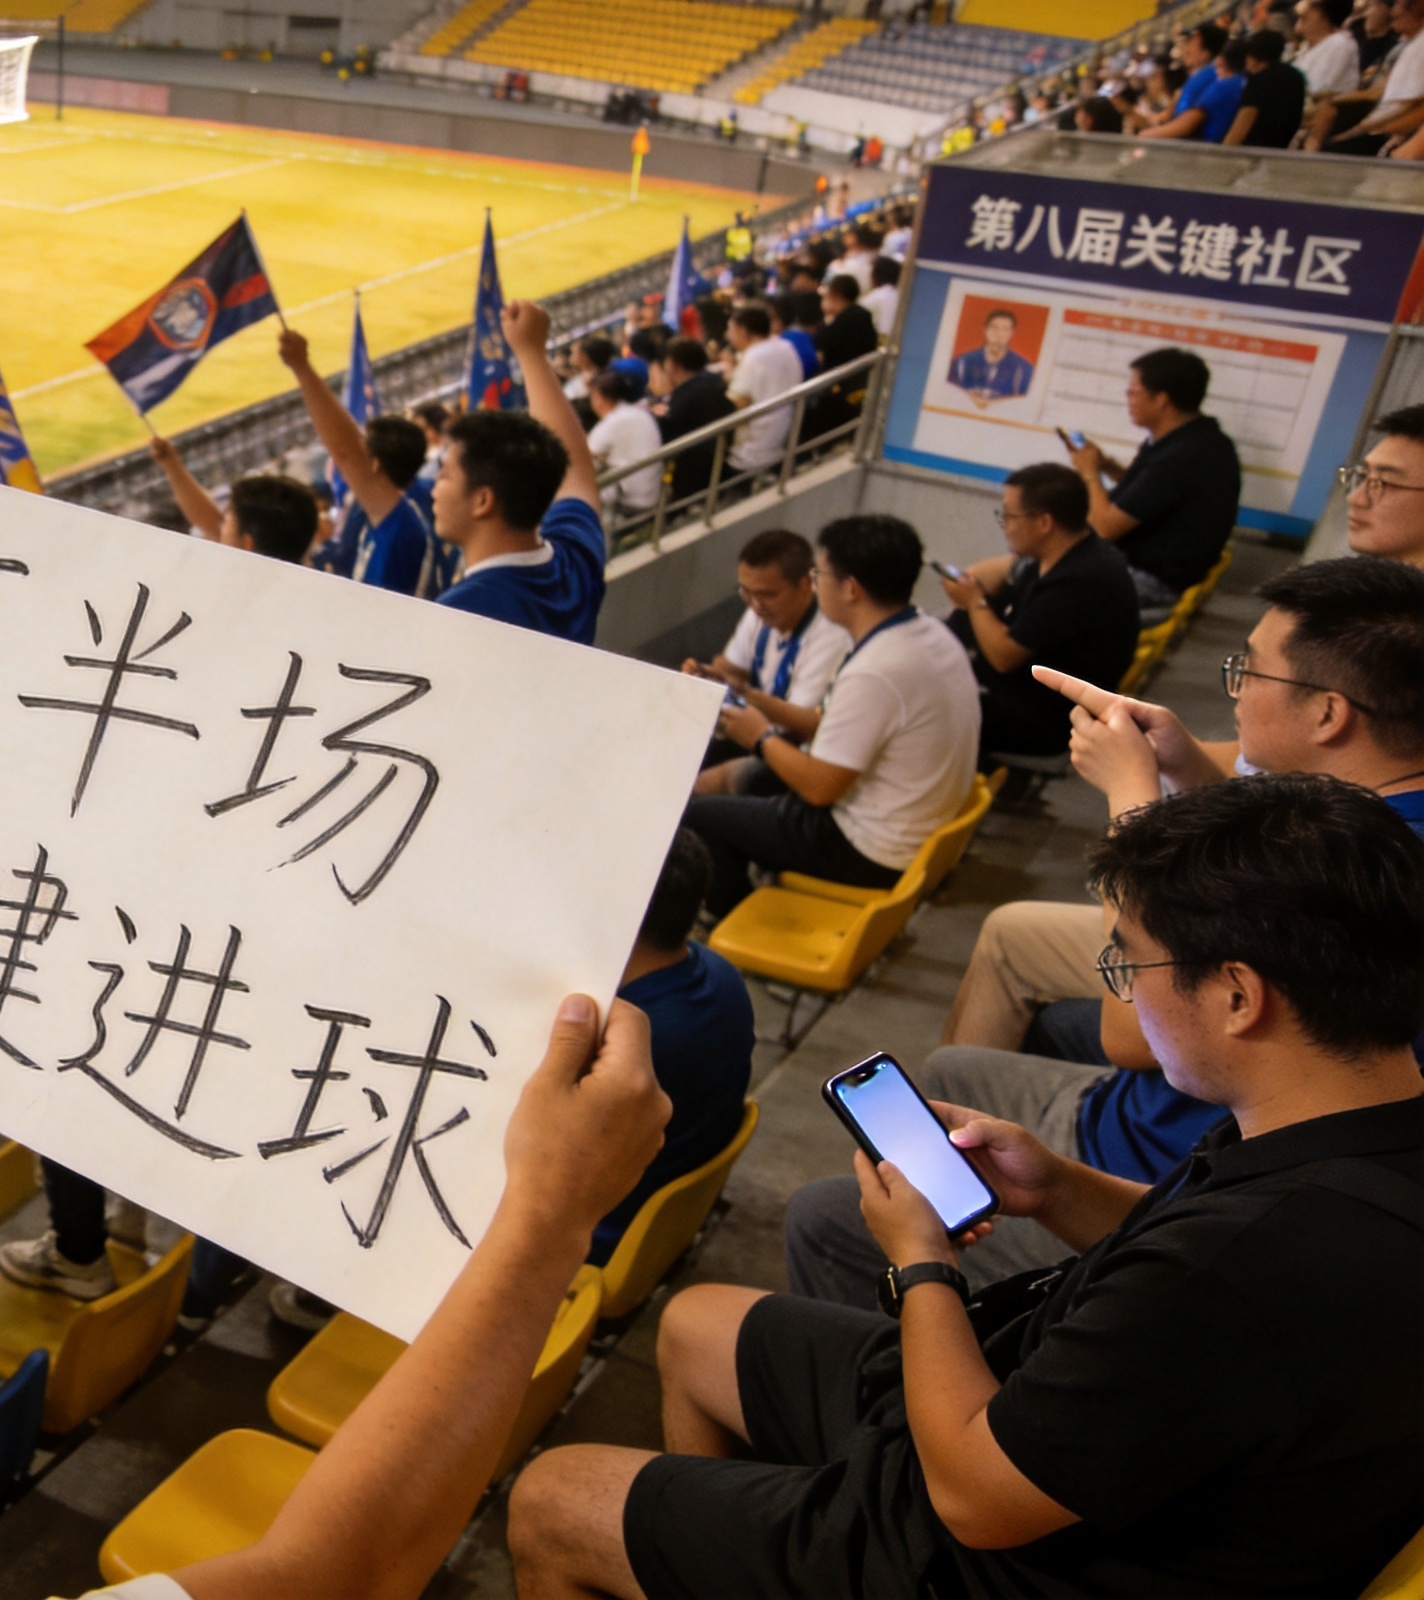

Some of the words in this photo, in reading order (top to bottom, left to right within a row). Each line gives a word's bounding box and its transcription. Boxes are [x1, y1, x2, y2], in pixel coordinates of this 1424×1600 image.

[966, 194, 1362, 296] 第八届关键社区
